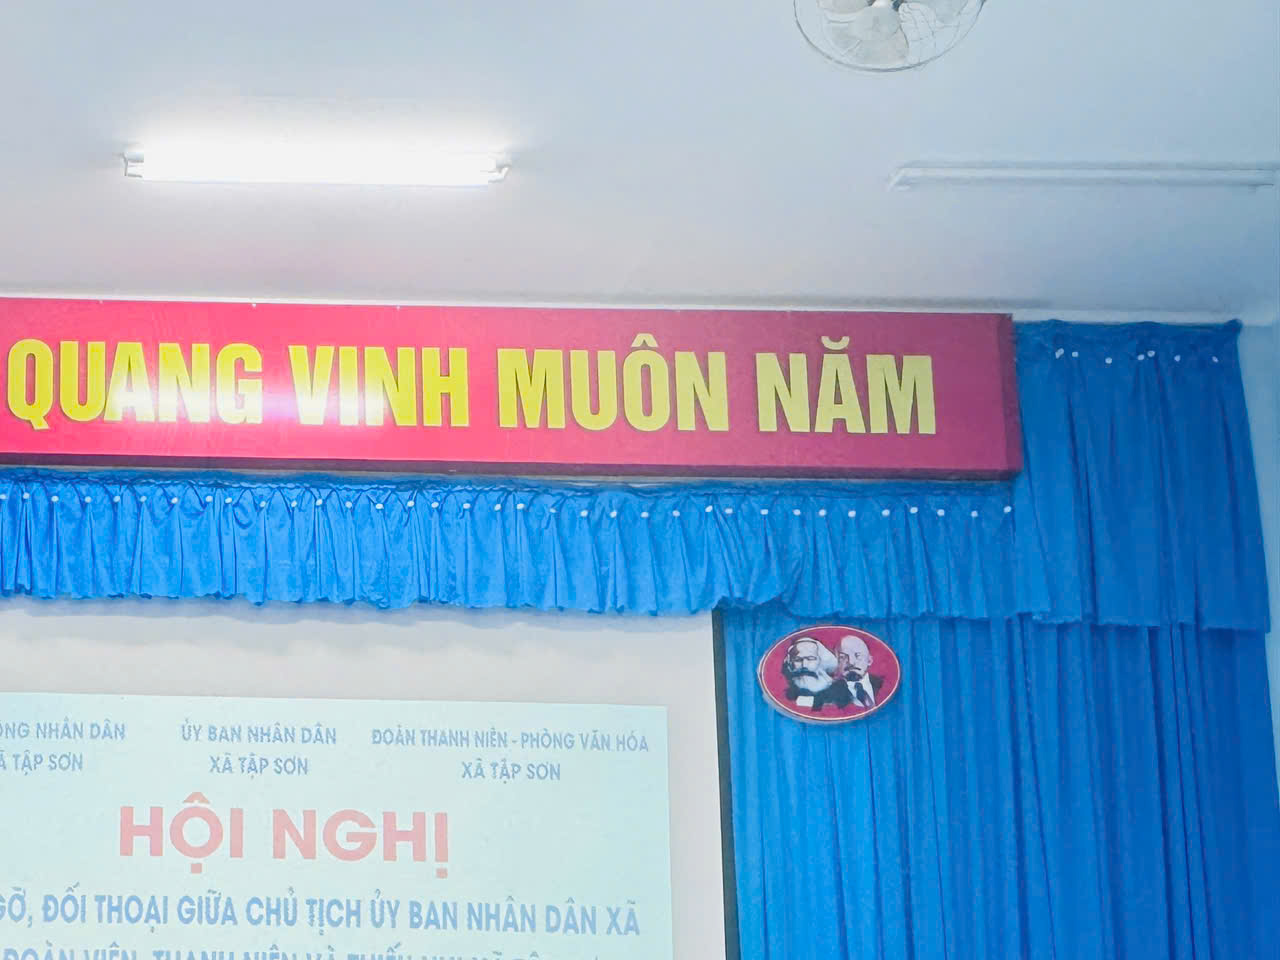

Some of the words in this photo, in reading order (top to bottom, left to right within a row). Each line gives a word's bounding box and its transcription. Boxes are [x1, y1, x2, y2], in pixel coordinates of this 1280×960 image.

[6, 338, 263, 431] QUANG
[288, 344, 469, 427] VINH
[496, 332, 730, 432] MUÔN
[755, 335, 937, 435] NĂM
[35, 716, 84, 740] NHÂN
[90, 718, 126, 741] DÂN
[207, 724, 242, 743] BAN
[247, 721, 296, 745] NHÂN
[301, 723, 337, 745] DÂN
[371, 724, 416, 747] ĐOÀN
[420, 729, 470, 748] THANH
[474, 726, 508, 749] NIÊN
[521, 728, 575, 750] PHÒNG
[579, 729, 611, 752] VĂN
[615, 731, 649, 753] HÓA
[12, 749, 43, 776] TẬP
[47, 752, 84, 772] SƠN
[208, 753, 234, 774] XÃ
[238, 753, 269, 780] TẬP
[273, 755, 309, 776] SƠN
[461, 757, 486, 780] XÃ
[491, 757, 521, 785] TẬP
[526, 760, 561, 781] SƠN
[119, 791, 244, 874] HỘI
[272, 808, 449, 879] NGHỊ
[42, 882, 87, 924] ĐỐI
[94, 894, 169, 934] THOẠI
[176, 888, 238, 926] GIỮA
[245, 886, 298, 926] CHỦ
[306, 898, 362, 936] TỊCH
[370, 888, 401, 929] ỦY
[409, 900, 458, 931] BAN
[467, 895, 537, 933] NHÂN
[545, 897, 597, 935] DÂN
[606, 899, 640, 936] XÃ
